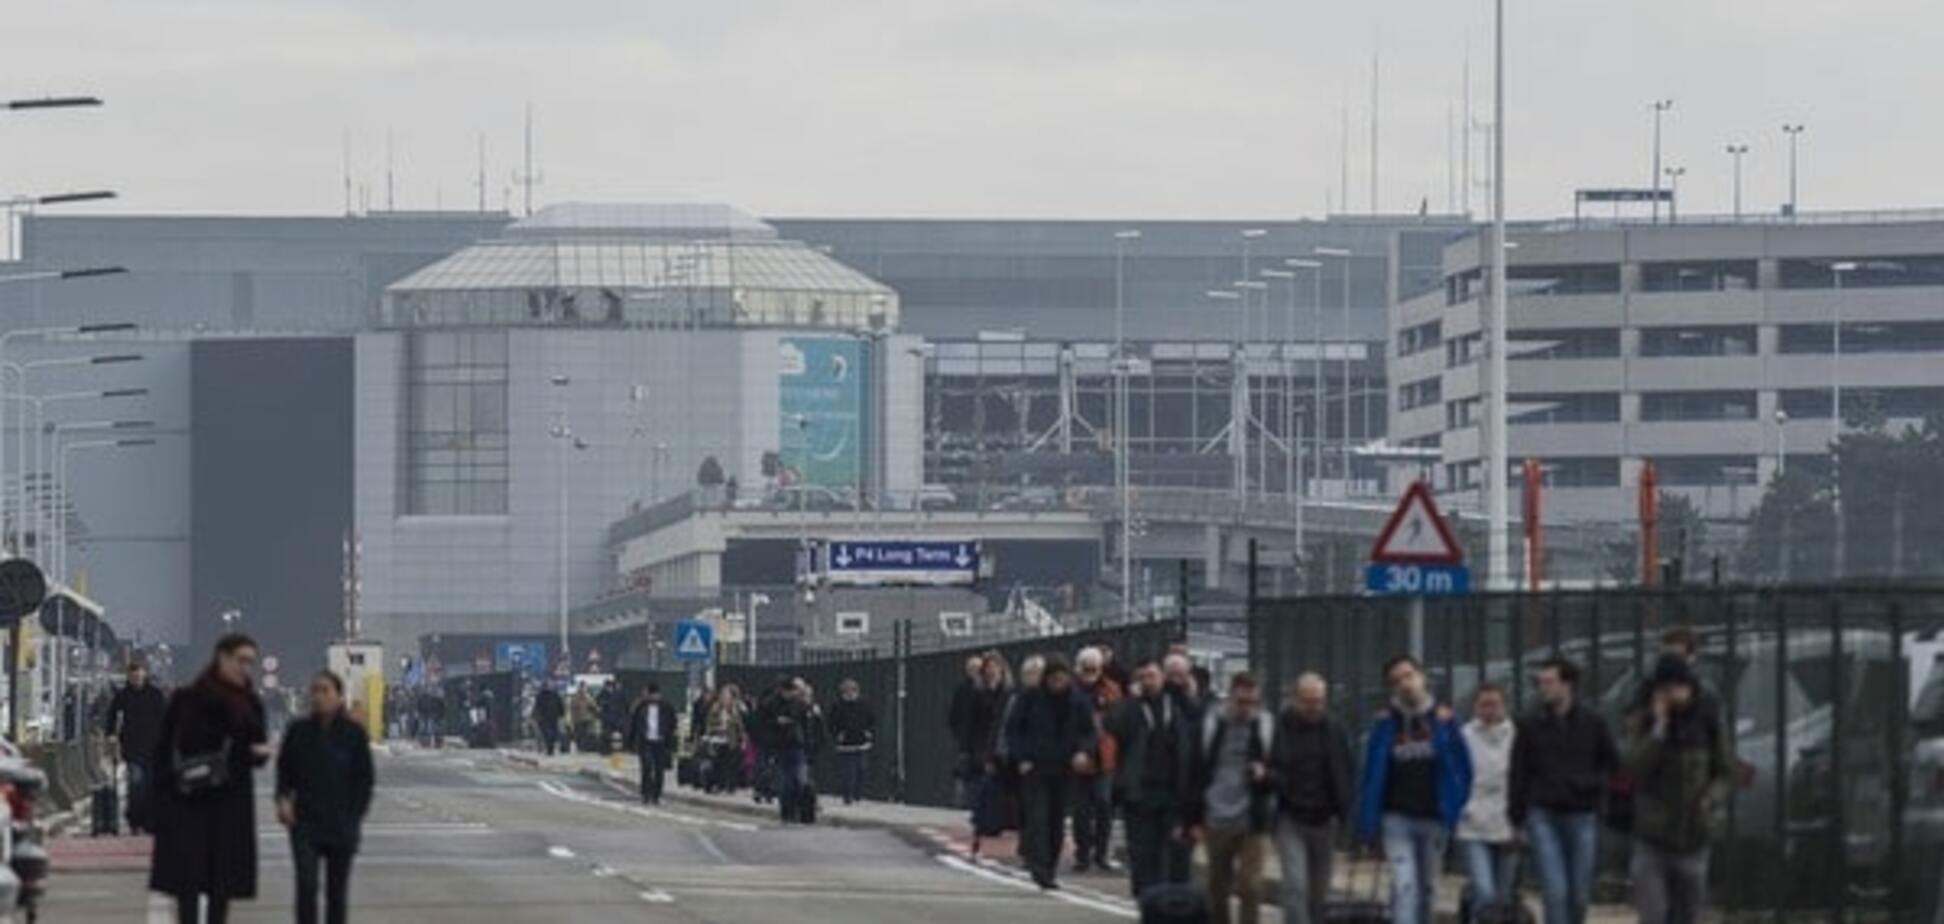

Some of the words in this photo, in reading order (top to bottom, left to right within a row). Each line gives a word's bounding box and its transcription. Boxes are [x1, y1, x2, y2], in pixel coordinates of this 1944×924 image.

[855, 547, 873, 561] P4
[878, 547, 912, 564] Long
[916, 547, 950, 561] Term
[1385, 565, 1421, 592] 30
[1426, 571, 1452, 592] m
